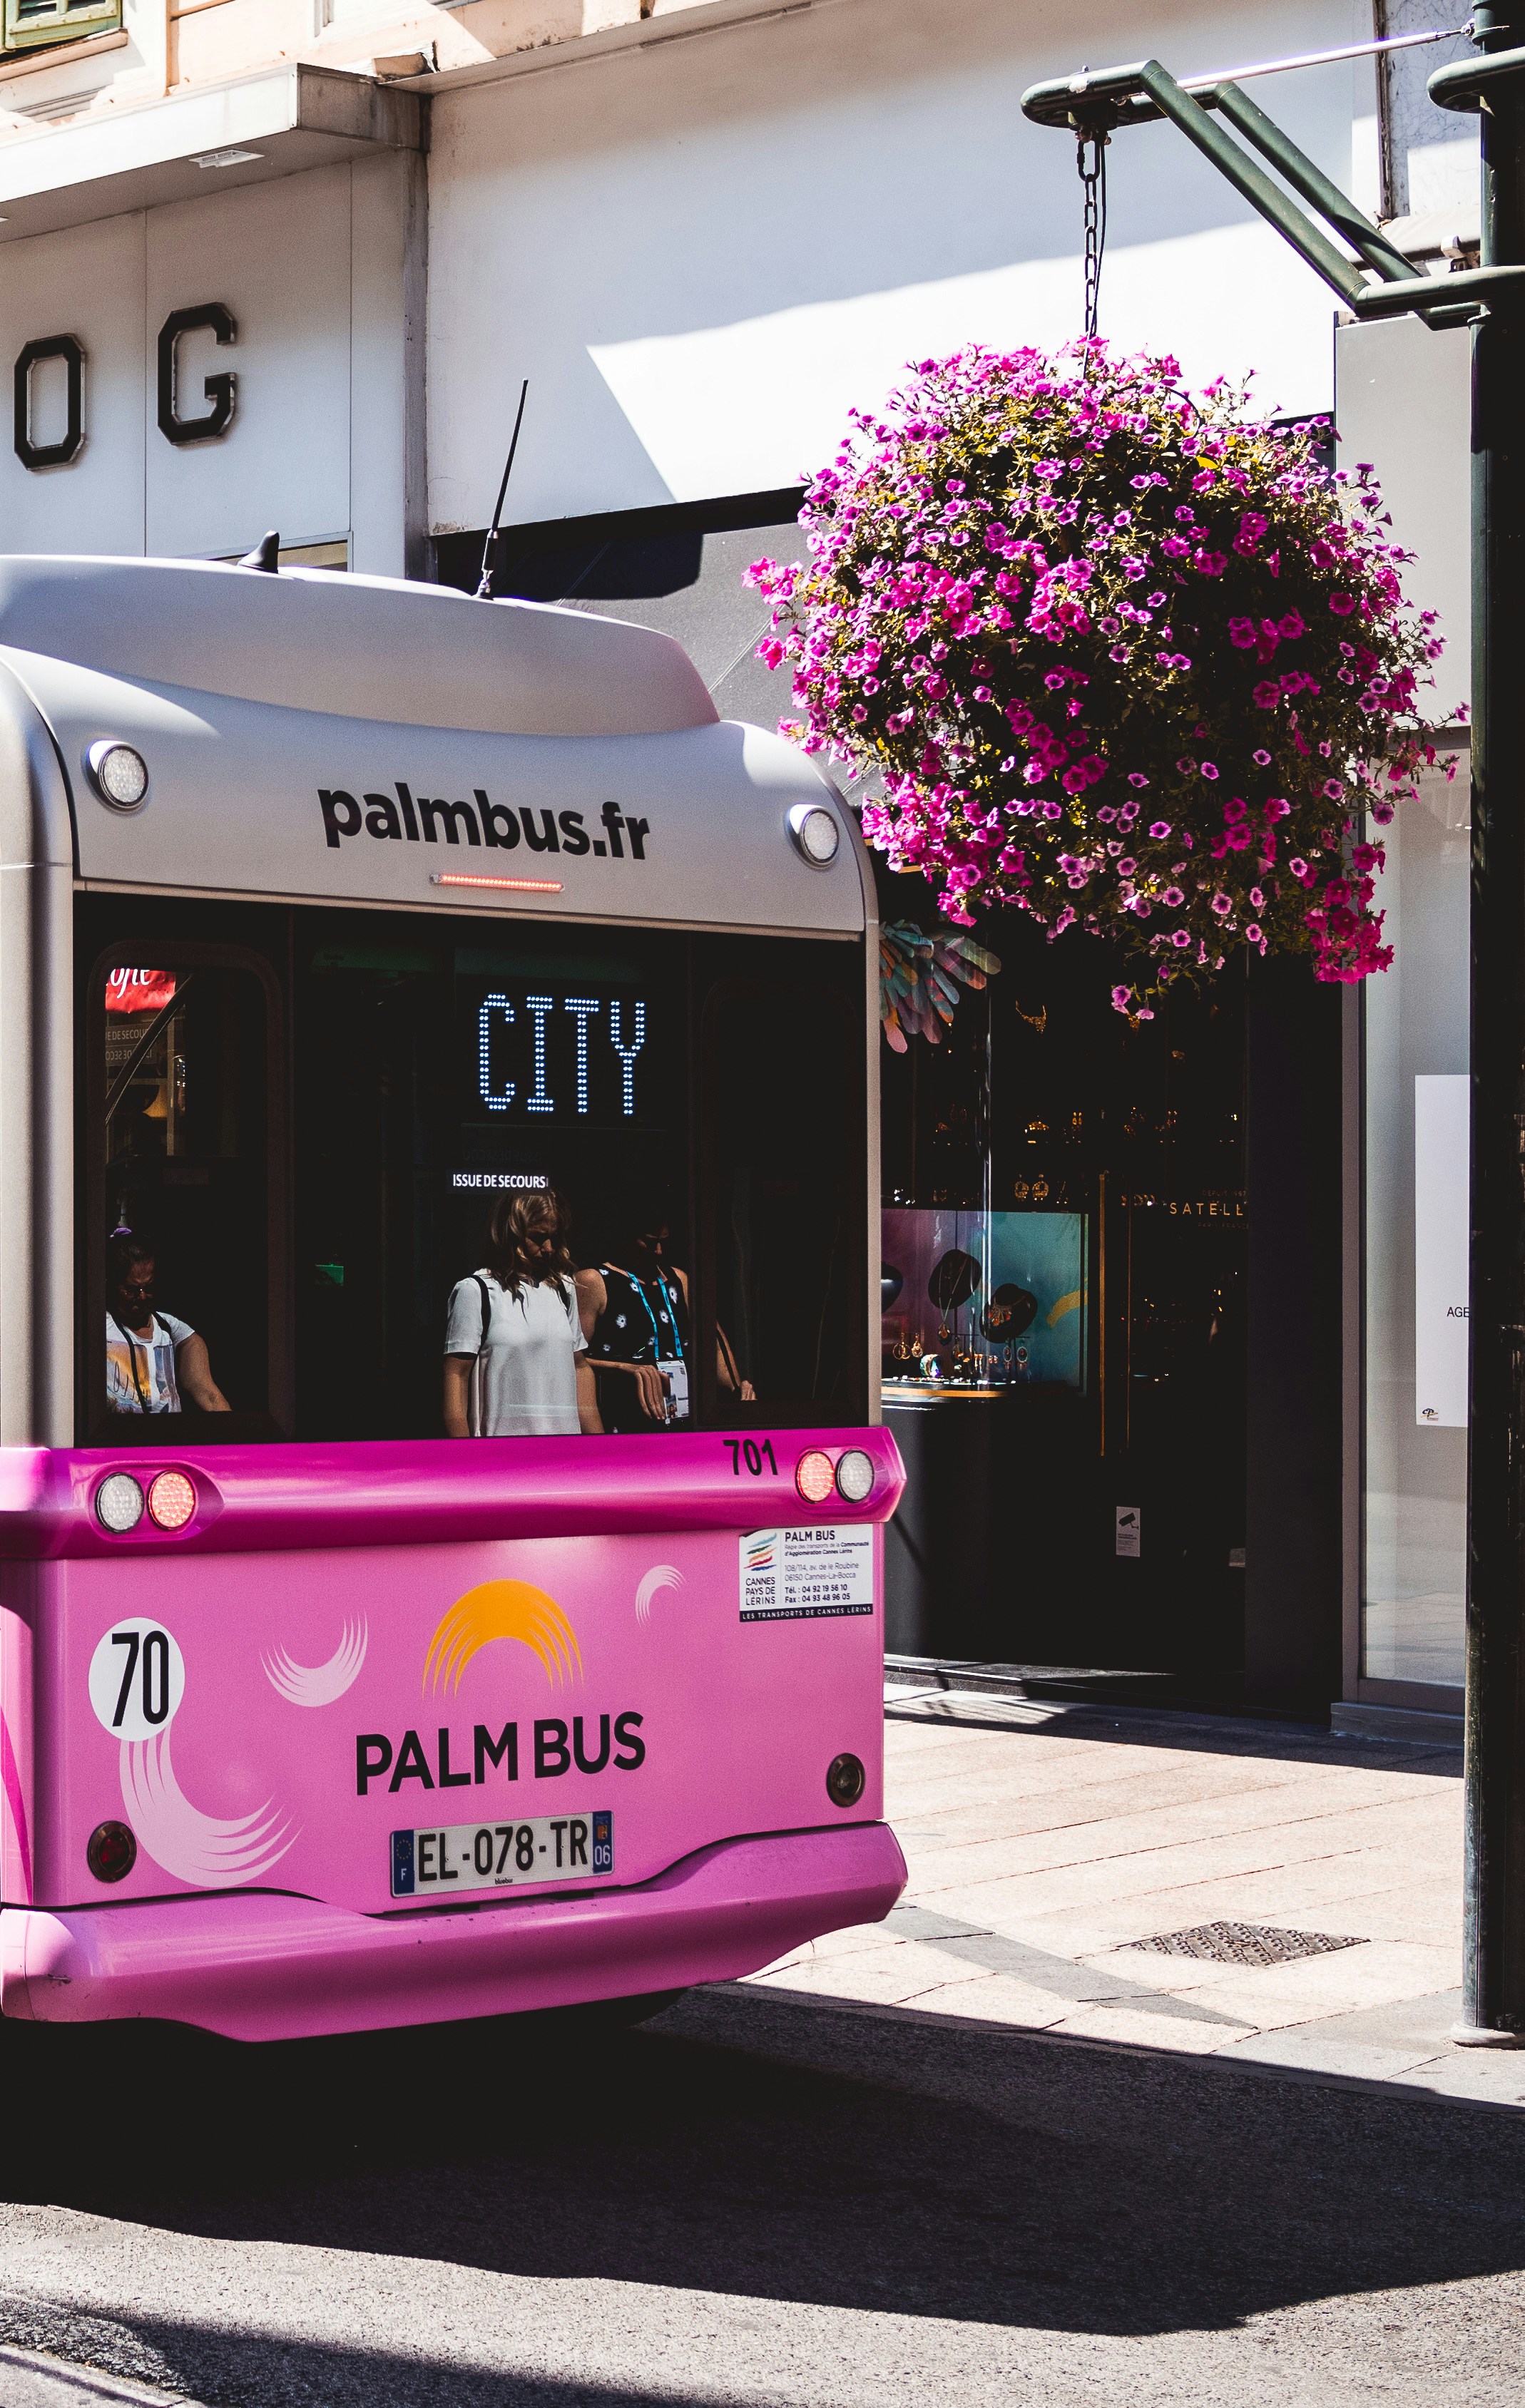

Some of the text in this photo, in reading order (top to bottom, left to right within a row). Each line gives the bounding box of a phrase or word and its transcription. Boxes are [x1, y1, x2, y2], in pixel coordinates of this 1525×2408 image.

[317, 782, 650, 860] palmbus.fr
[479, 994, 645, 1115] CITY
[453, 1174, 546, 1188] ISSUE DE SECOURS
[1170, 1202, 1243, 1216] SATELL
[723, 1439, 777, 1476] 701
[785, 1530, 835, 1542] PALM BUS
[745, 1577, 775, 1587] CANNES
[765, 1586, 775, 1594] DE
[745, 1596, 775, 1606] LÉRINS
[112, 1631, 169, 1727] 70
[357, 1711, 646, 1795] PALM BUS
[401, 1868, 407, 1880] F
[418, 1819, 588, 1882] EL-078-TR
[595, 1845, 611, 1865] 06
